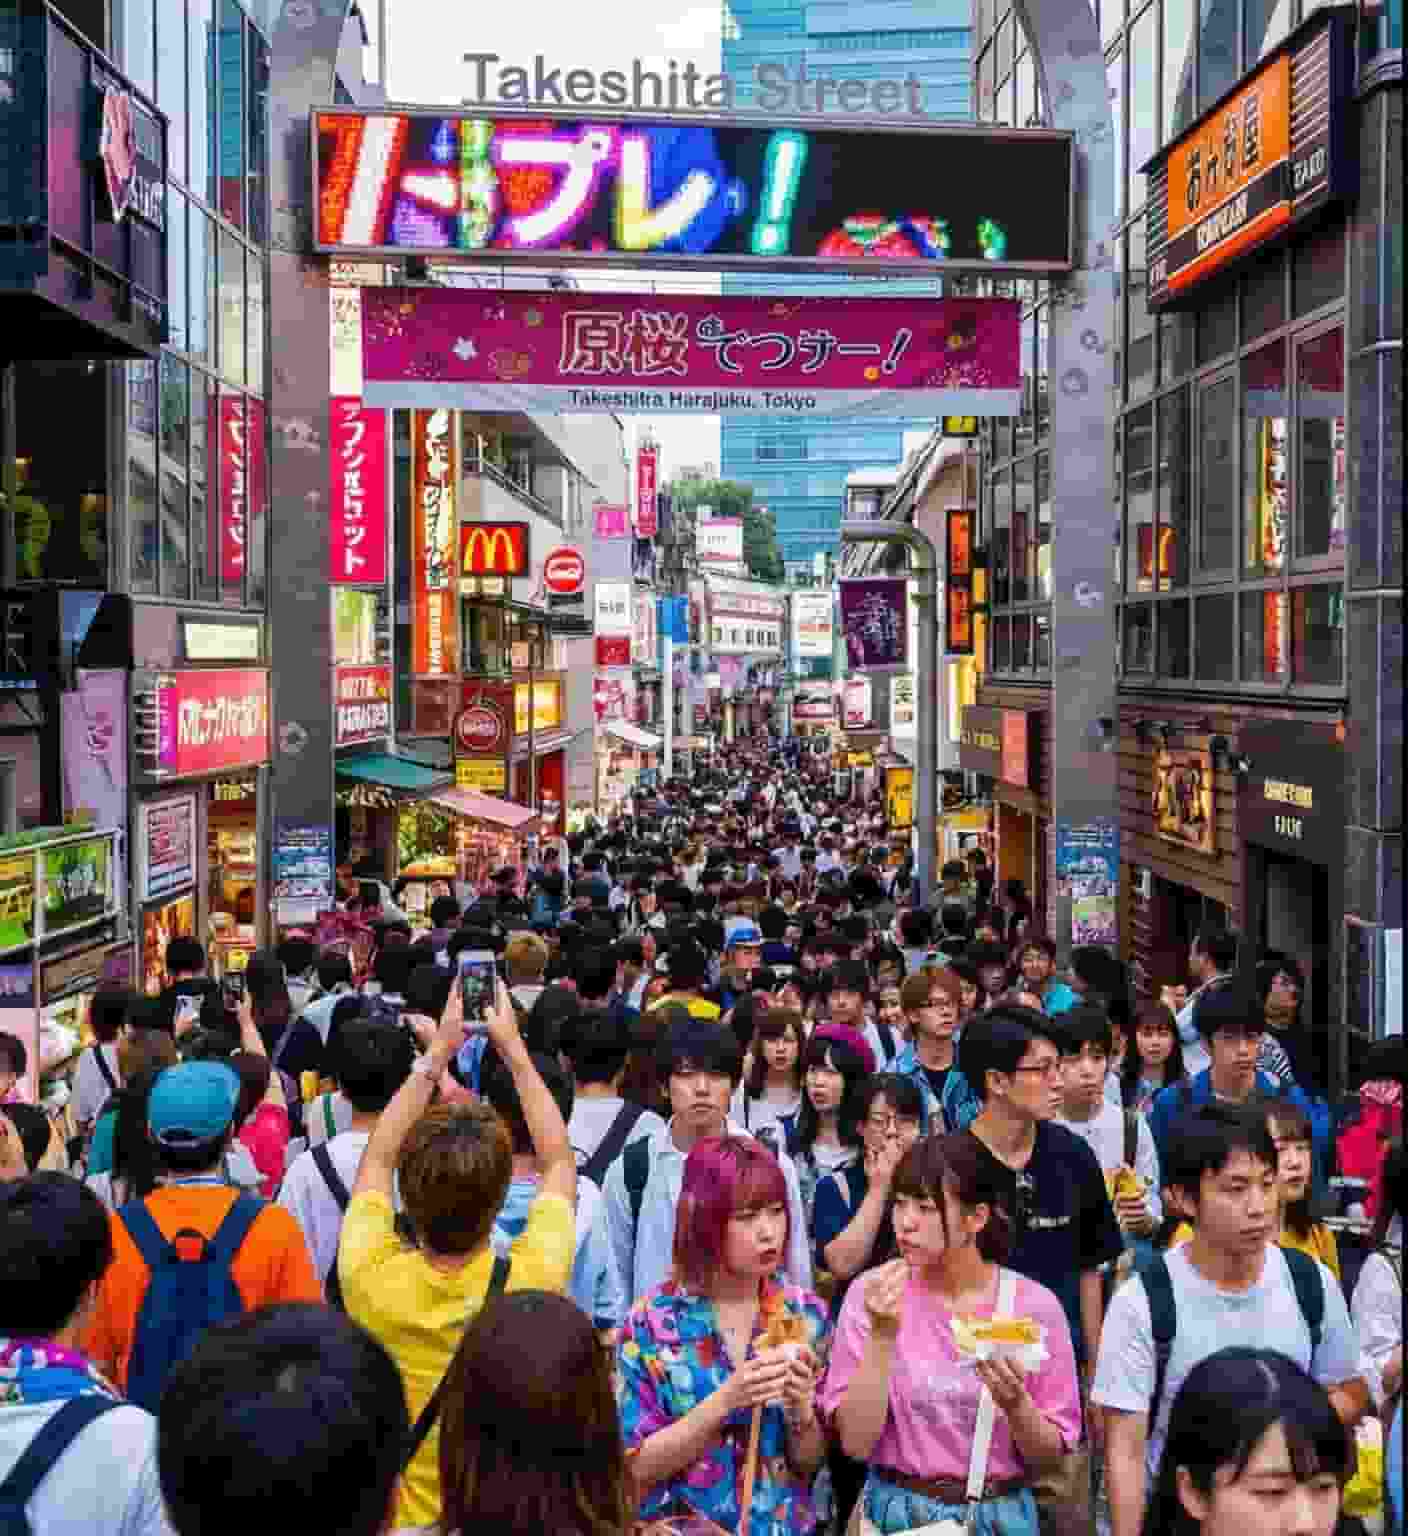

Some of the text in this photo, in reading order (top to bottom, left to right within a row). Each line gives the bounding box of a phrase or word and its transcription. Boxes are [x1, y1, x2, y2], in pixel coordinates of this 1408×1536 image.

[463, 53, 924, 113] Takeshita Street
[760, 390, 818, 412] Tokyo
